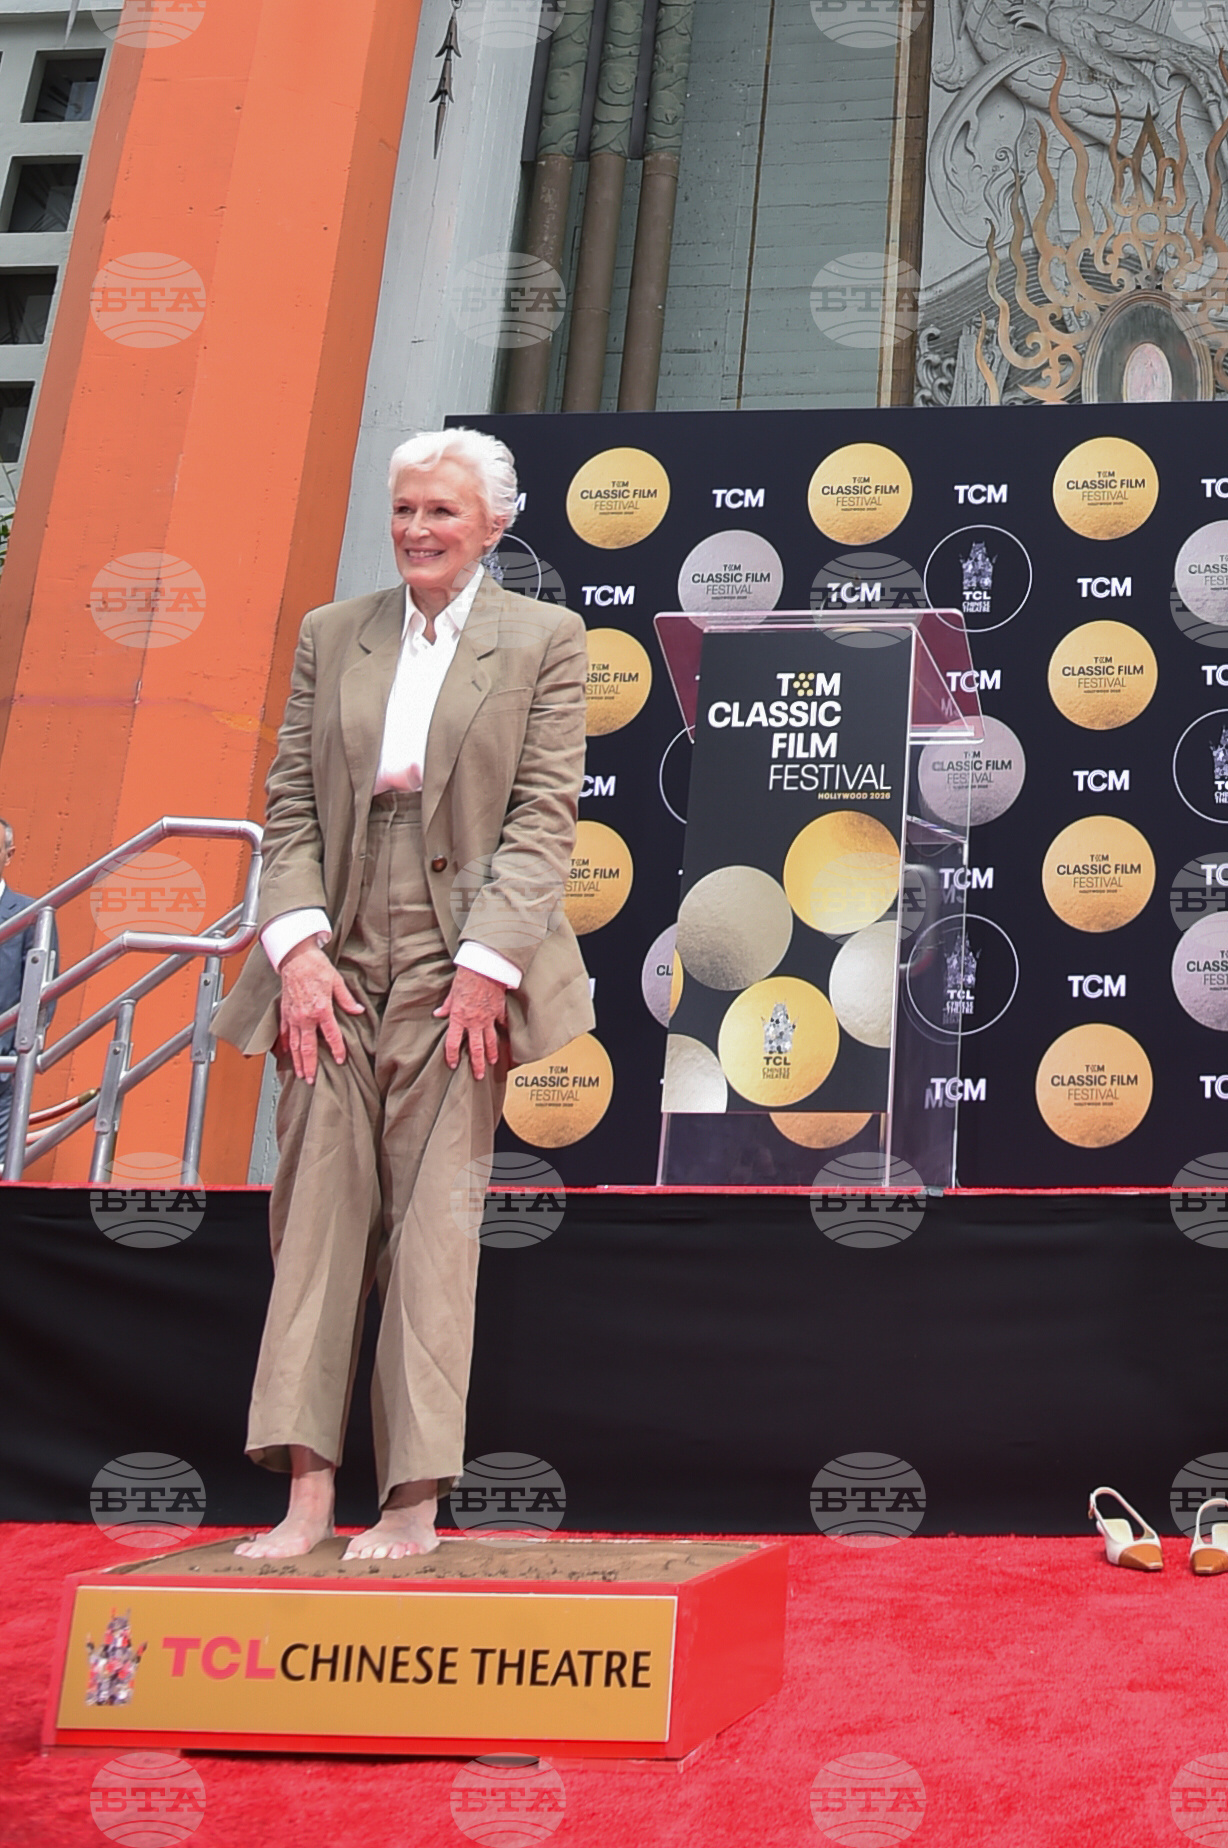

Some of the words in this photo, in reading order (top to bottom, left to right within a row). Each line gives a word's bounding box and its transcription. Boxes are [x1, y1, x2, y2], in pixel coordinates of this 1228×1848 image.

[822, 485, 872, 495] CLASSIC
[875, 485, 899, 494] FILM
[1067, 479, 1117, 490] CLASSIC
[1120, 479, 1145, 489] FILM
[580, 489, 629, 500] CLASSIC
[632, 489, 657, 499] FILM
[713, 489, 764, 509] TCM
[954, 485, 1008, 504] TCM
[1082, 490, 1128, 501] FESTIVAL
[594, 500, 639, 510] FESTIVAL
[836, 496, 882, 506] FESTIVAL
[692, 573, 742, 583] CLASSIC
[745, 572, 771, 582] FILM
[707, 584, 752, 594] FESTIVAL
[828, 583, 881, 603] TCM
[1077, 577, 1132, 598] TCM
[582, 586, 635, 606] TCM
[962, 591, 991, 600] TCL
[1062, 665, 1114, 676] CLASSIC
[1118, 665, 1144, 675] FILM
[585, 672, 610, 683] SSIC
[614, 672, 639, 682] FILM
[947, 670, 1001, 691] TCM
[1078, 677, 1127, 688] FESTIVAL
[585, 684, 621, 694] STIVAL
[708, 701, 842, 728] CLASSIC
[771, 733, 838, 758] FILM
[932, 760, 982, 771] CLASSIC
[986, 760, 1012, 770] FILM
[769, 764, 891, 790] FESTIVAL
[947, 772, 993, 783] FESTIVAL
[1073, 770, 1129, 791] TCM
[593, 868, 620, 879] FILM
[1057, 864, 1111, 875] CLASSIC
[1115, 863, 1141, 874] FILM
[940, 868, 993, 889] TCM
[1073, 876, 1123, 887] FESTIVAL
[564, 881, 600, 891] STIVAL
[1068, 975, 1126, 997] TCM
[947, 990, 974, 1000] TCL
[764, 1056, 790, 1065] TCL
[515, 1076, 569, 1088] CLASSIC
[572, 1076, 599, 1087] FILM
[1051, 1074, 1107, 1086] CLASSIC
[1110, 1074, 1138, 1085] FILM
[931, 1079, 986, 1100] TCM
[1068, 1088, 1119, 1100] FESTIVAL
[530, 1090, 579, 1101] FESTIVAL
[162, 1636, 276, 1679] TCL
[281, 1643, 459, 1685] CHINESE
[472, 1646, 651, 1688] THEATRE
